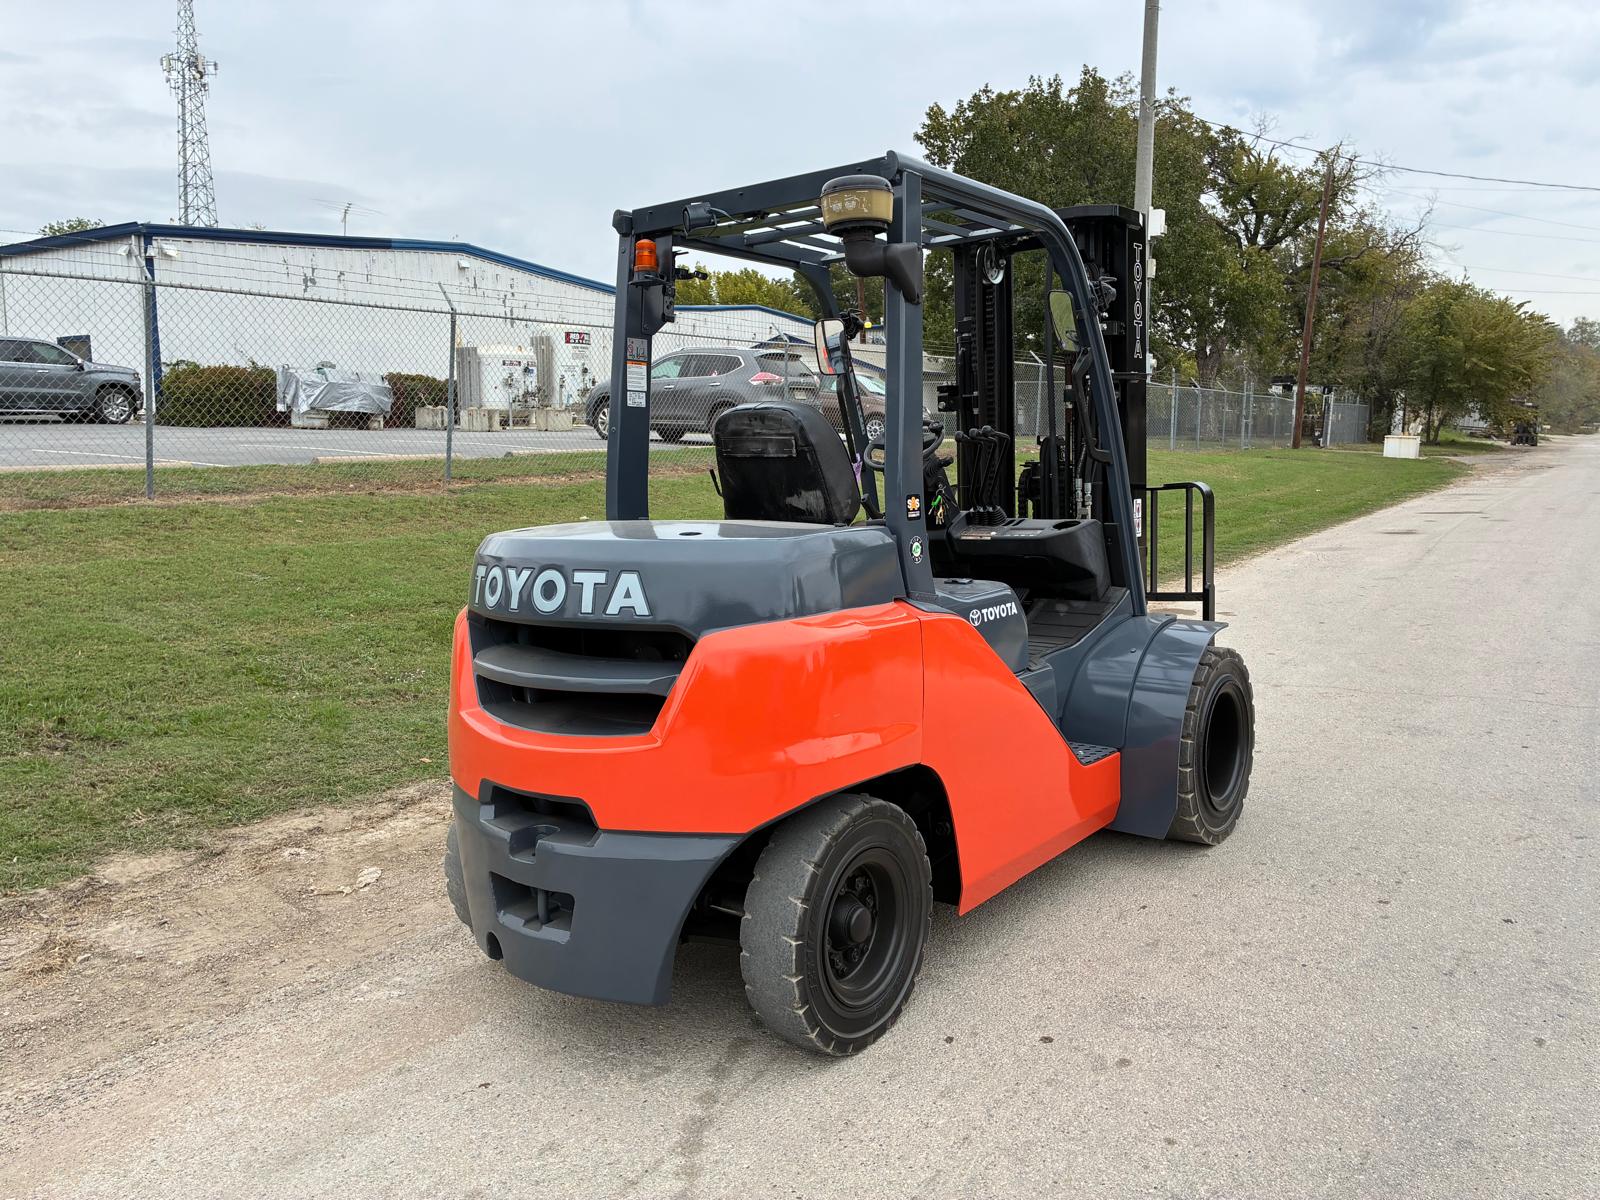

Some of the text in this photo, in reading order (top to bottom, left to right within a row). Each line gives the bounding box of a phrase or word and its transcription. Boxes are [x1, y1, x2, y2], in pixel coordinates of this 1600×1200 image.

[1133, 242, 1143, 359] TOYOTA
[474, 564, 650, 616] TOYOTA
[981, 601, 1018, 622] TOYOTA
